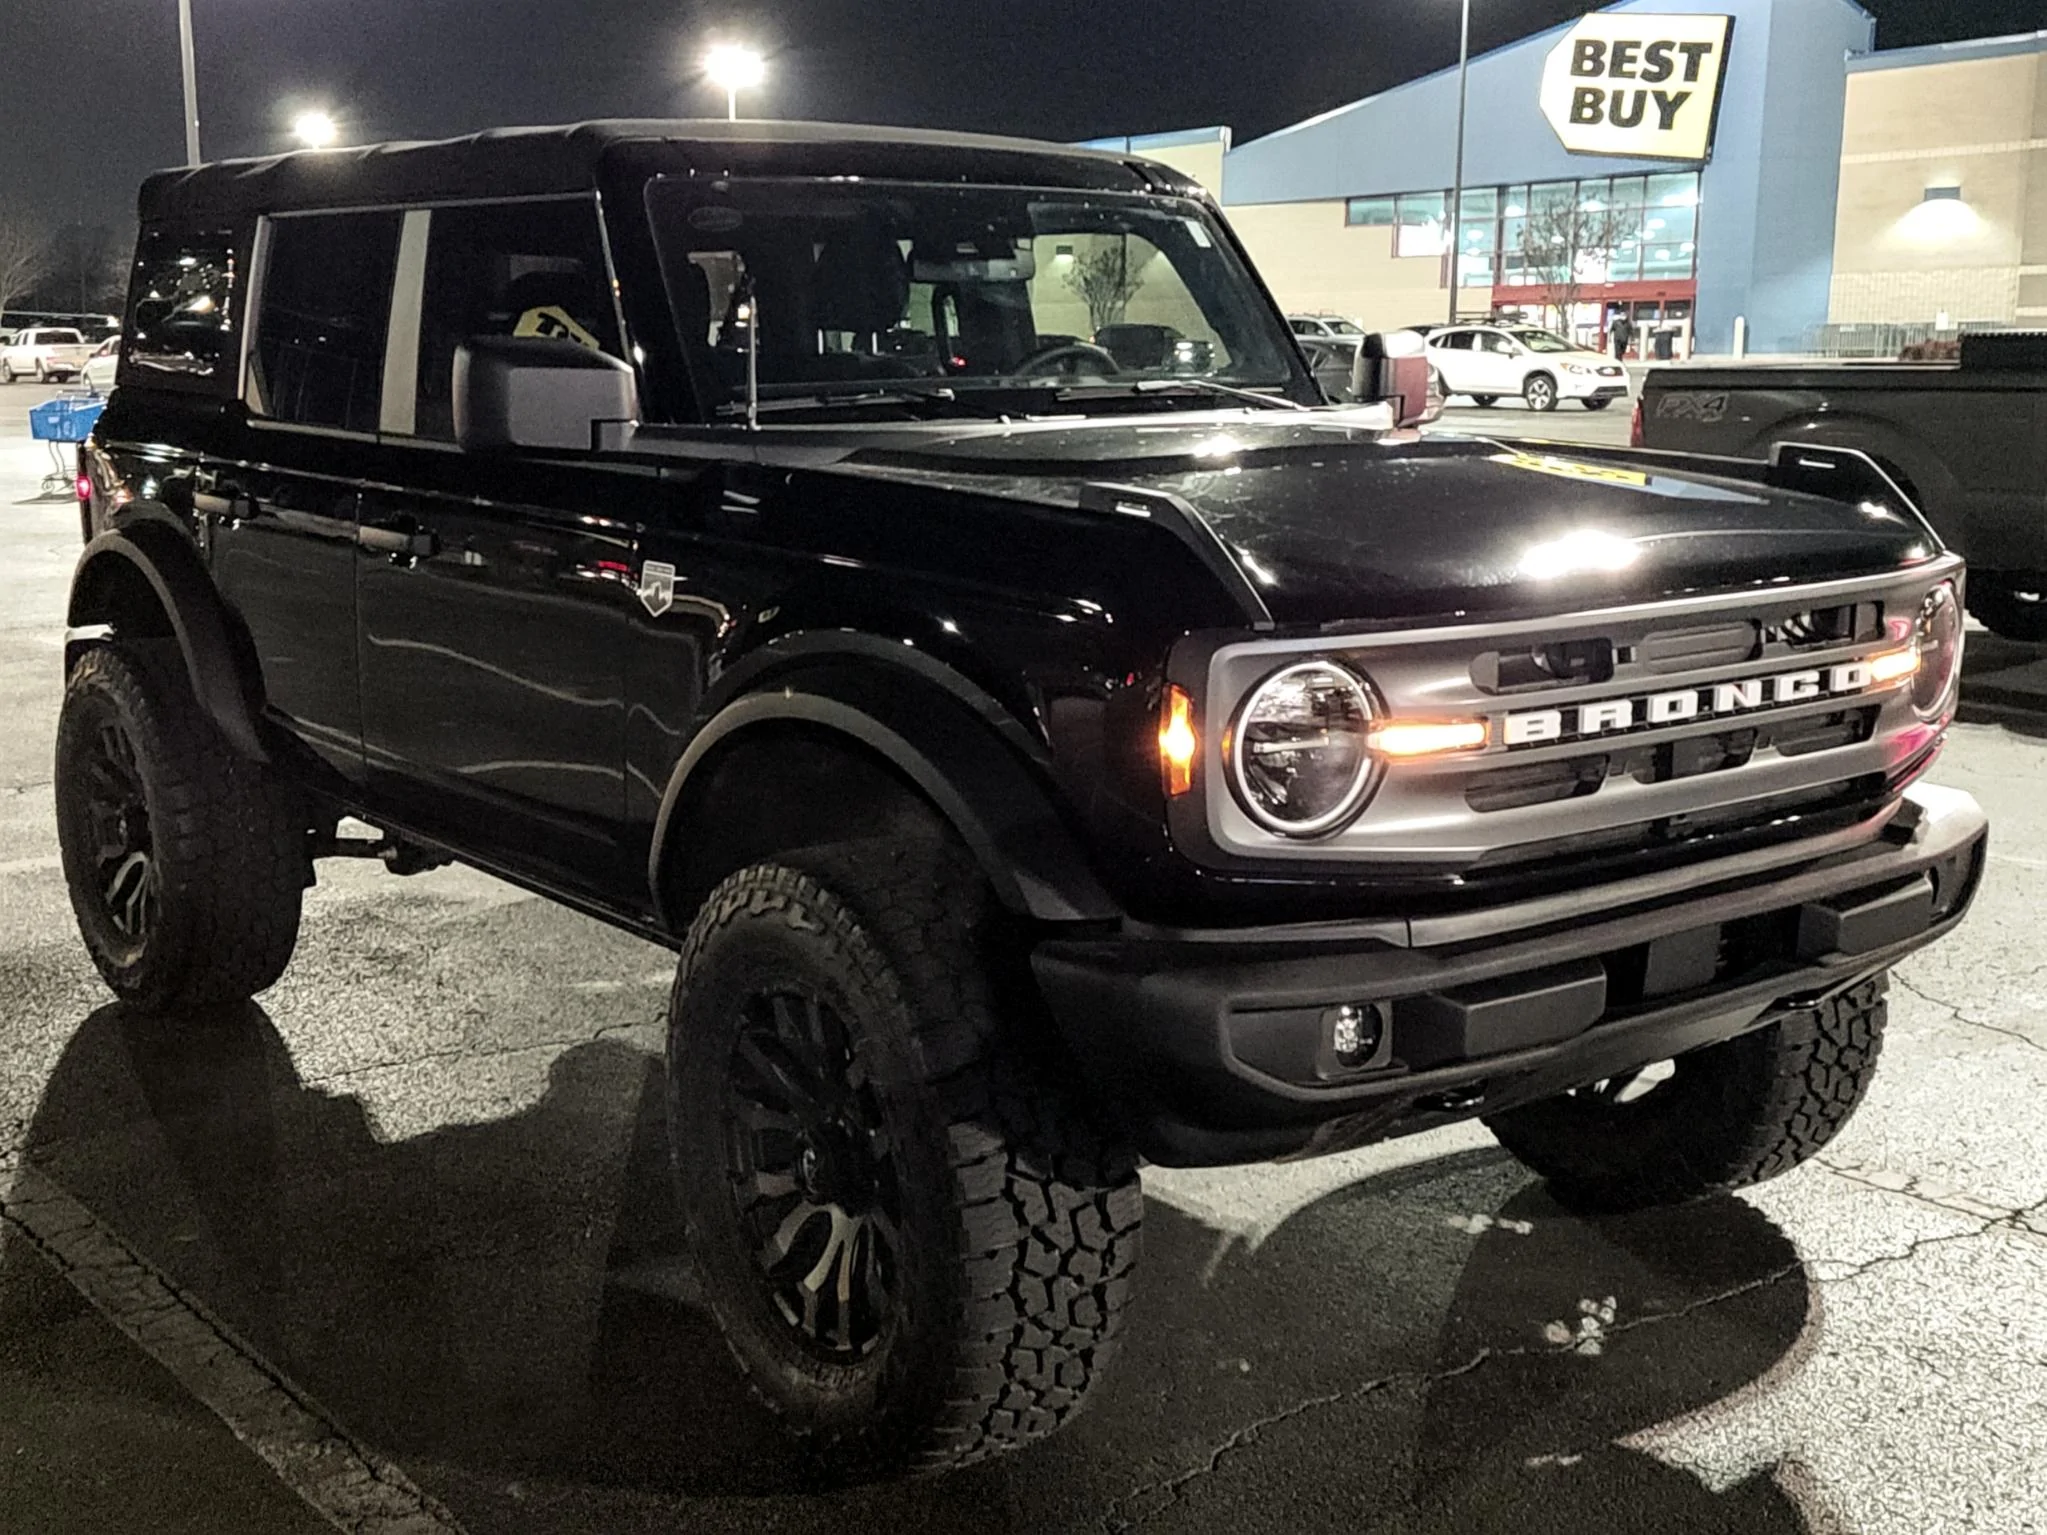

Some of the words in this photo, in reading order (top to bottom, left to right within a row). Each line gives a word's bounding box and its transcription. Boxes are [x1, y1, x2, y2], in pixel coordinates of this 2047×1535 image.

[1570, 39, 1713, 83] BEST
[1569, 87, 1692, 130] BUY
[1656, 392, 1729, 422] FX4
[1503, 661, 1872, 745] BRONCO
